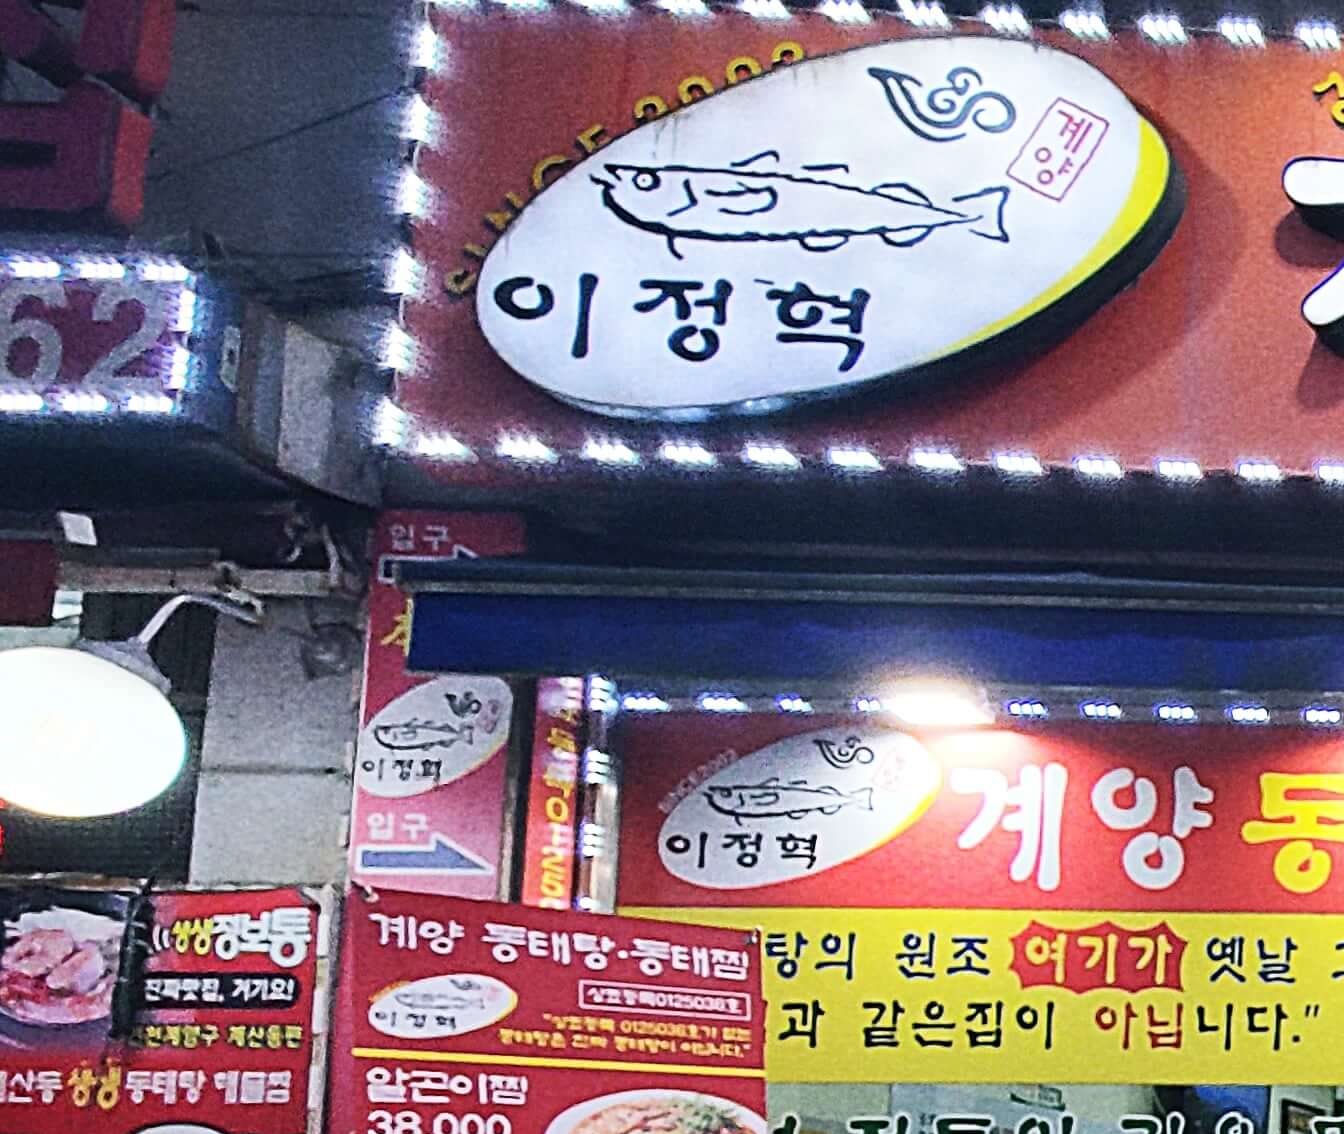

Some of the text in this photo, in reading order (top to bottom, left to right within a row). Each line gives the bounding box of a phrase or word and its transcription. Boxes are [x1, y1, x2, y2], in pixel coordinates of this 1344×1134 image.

[492, 272, 872, 372] 이정혁
[389, 524, 451, 550] 입구
[367, 812, 430, 842] 입구
[949, 763, 1214, 892] 계양
[665, 831, 819, 870] 이정혁
[368, 911, 467, 957] 계양
[895, 931, 992, 978] 원조
[1024, 934, 1176, 987] 여기가
[1205, 935, 1299, 987] 옛날
[778, 1000, 826, 1048] 과
[861, 1000, 1056, 1049] 같은집이
[0, 1070, 63, 1105] 산동
[366, 1066, 529, 1106] 알곤이찜
